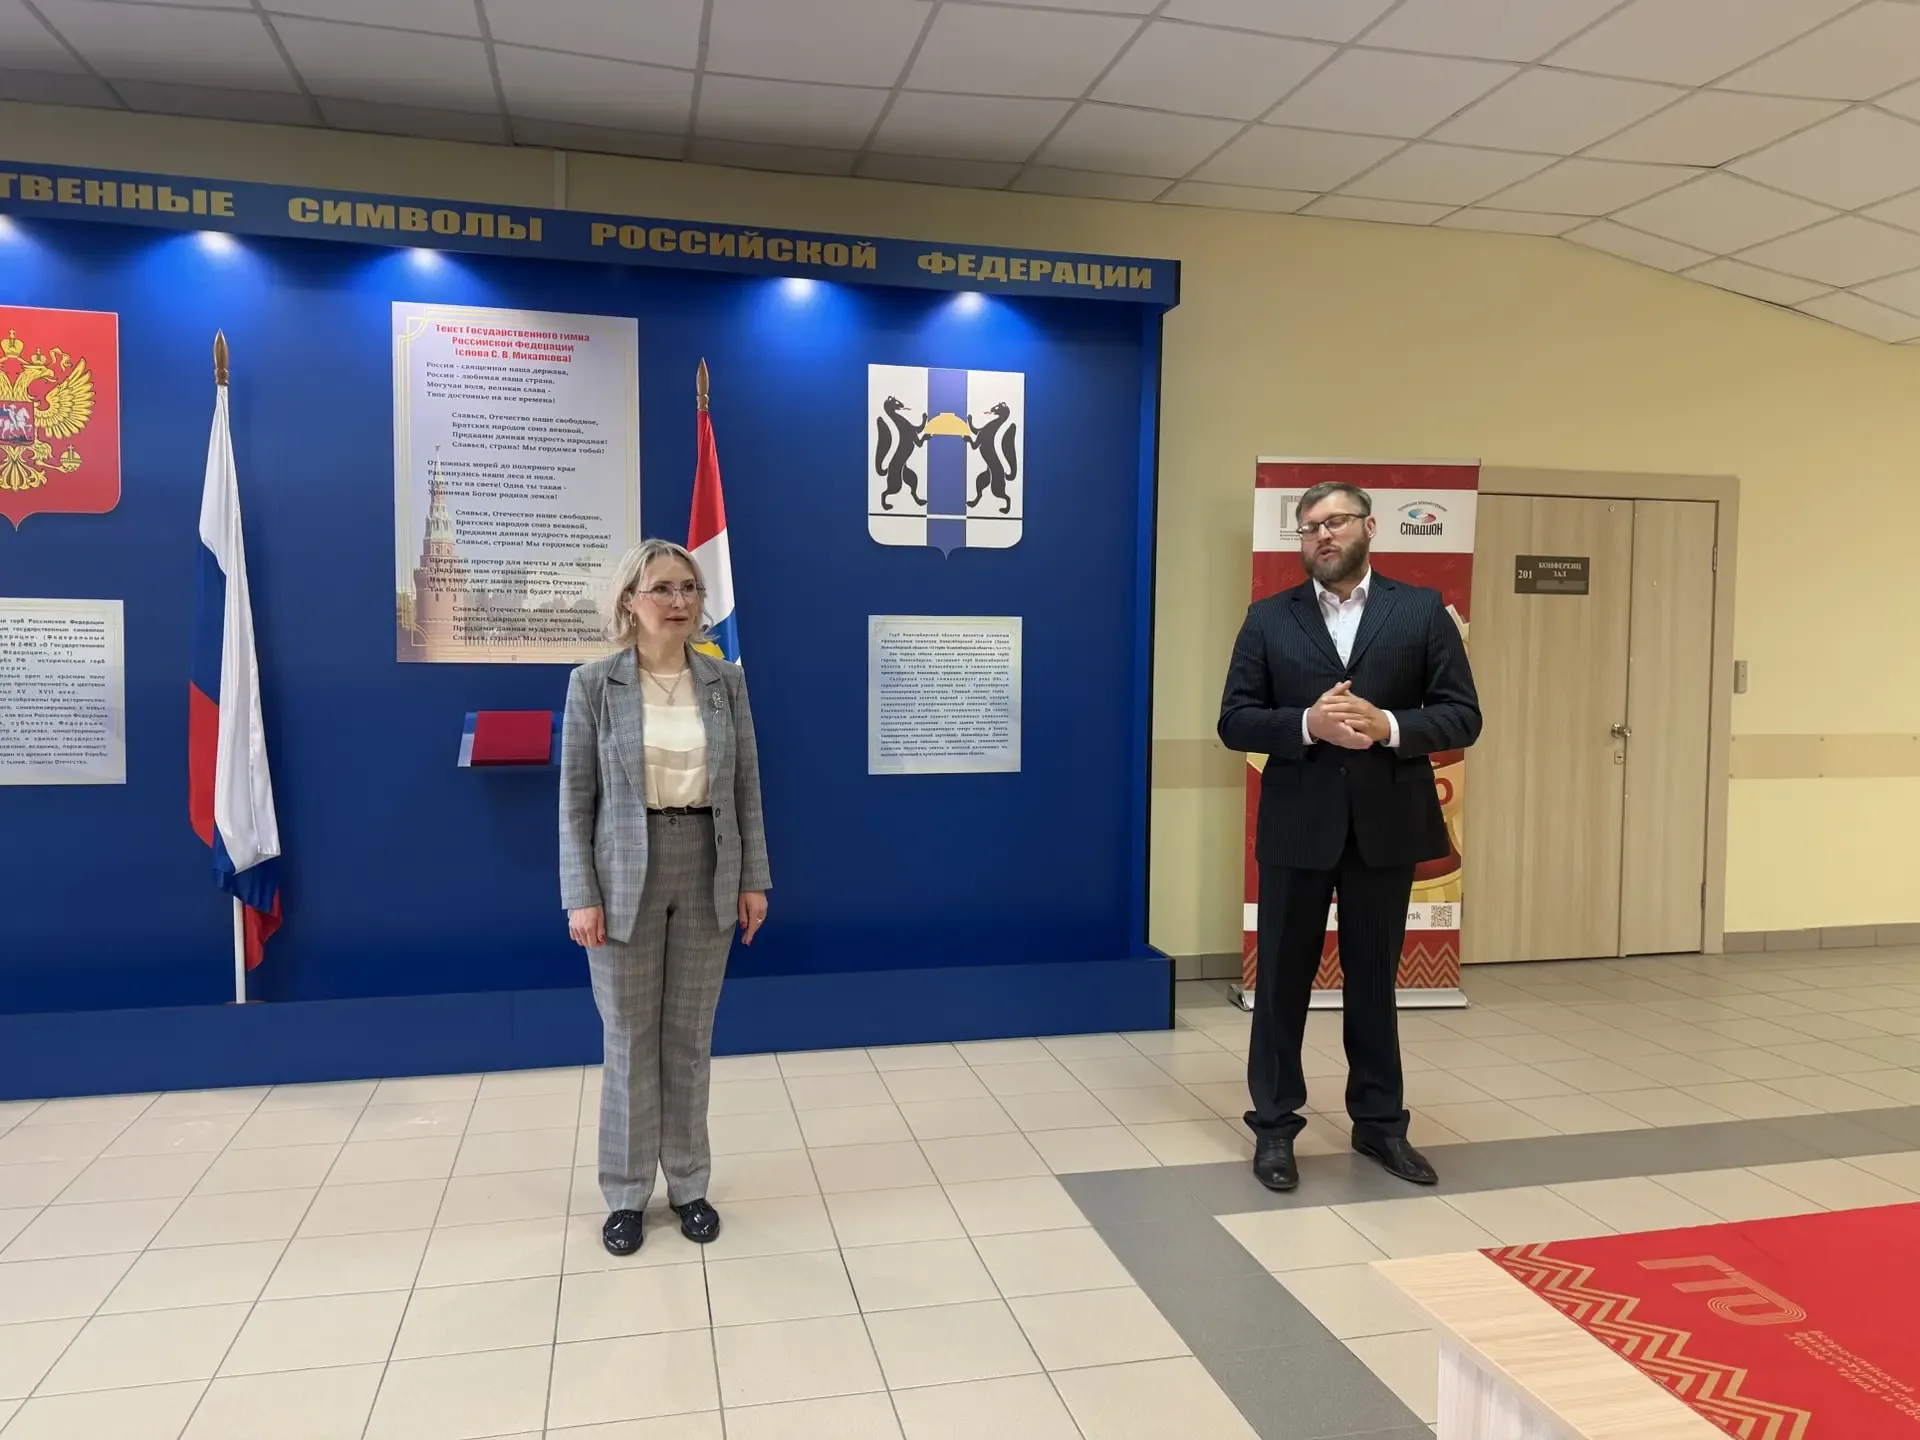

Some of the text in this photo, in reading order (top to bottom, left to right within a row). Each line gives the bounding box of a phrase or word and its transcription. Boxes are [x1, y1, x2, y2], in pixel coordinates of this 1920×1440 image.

[0, 172, 1152, 289] ТВЕННЫЕ СИМВОЛЫ РОССИЙСКОЙ ФЕДЕРАЦИИ
[1538, 562, 1582, 570] КОНФЕРЕНЦ
[1518, 570, 1532, 579] 201
